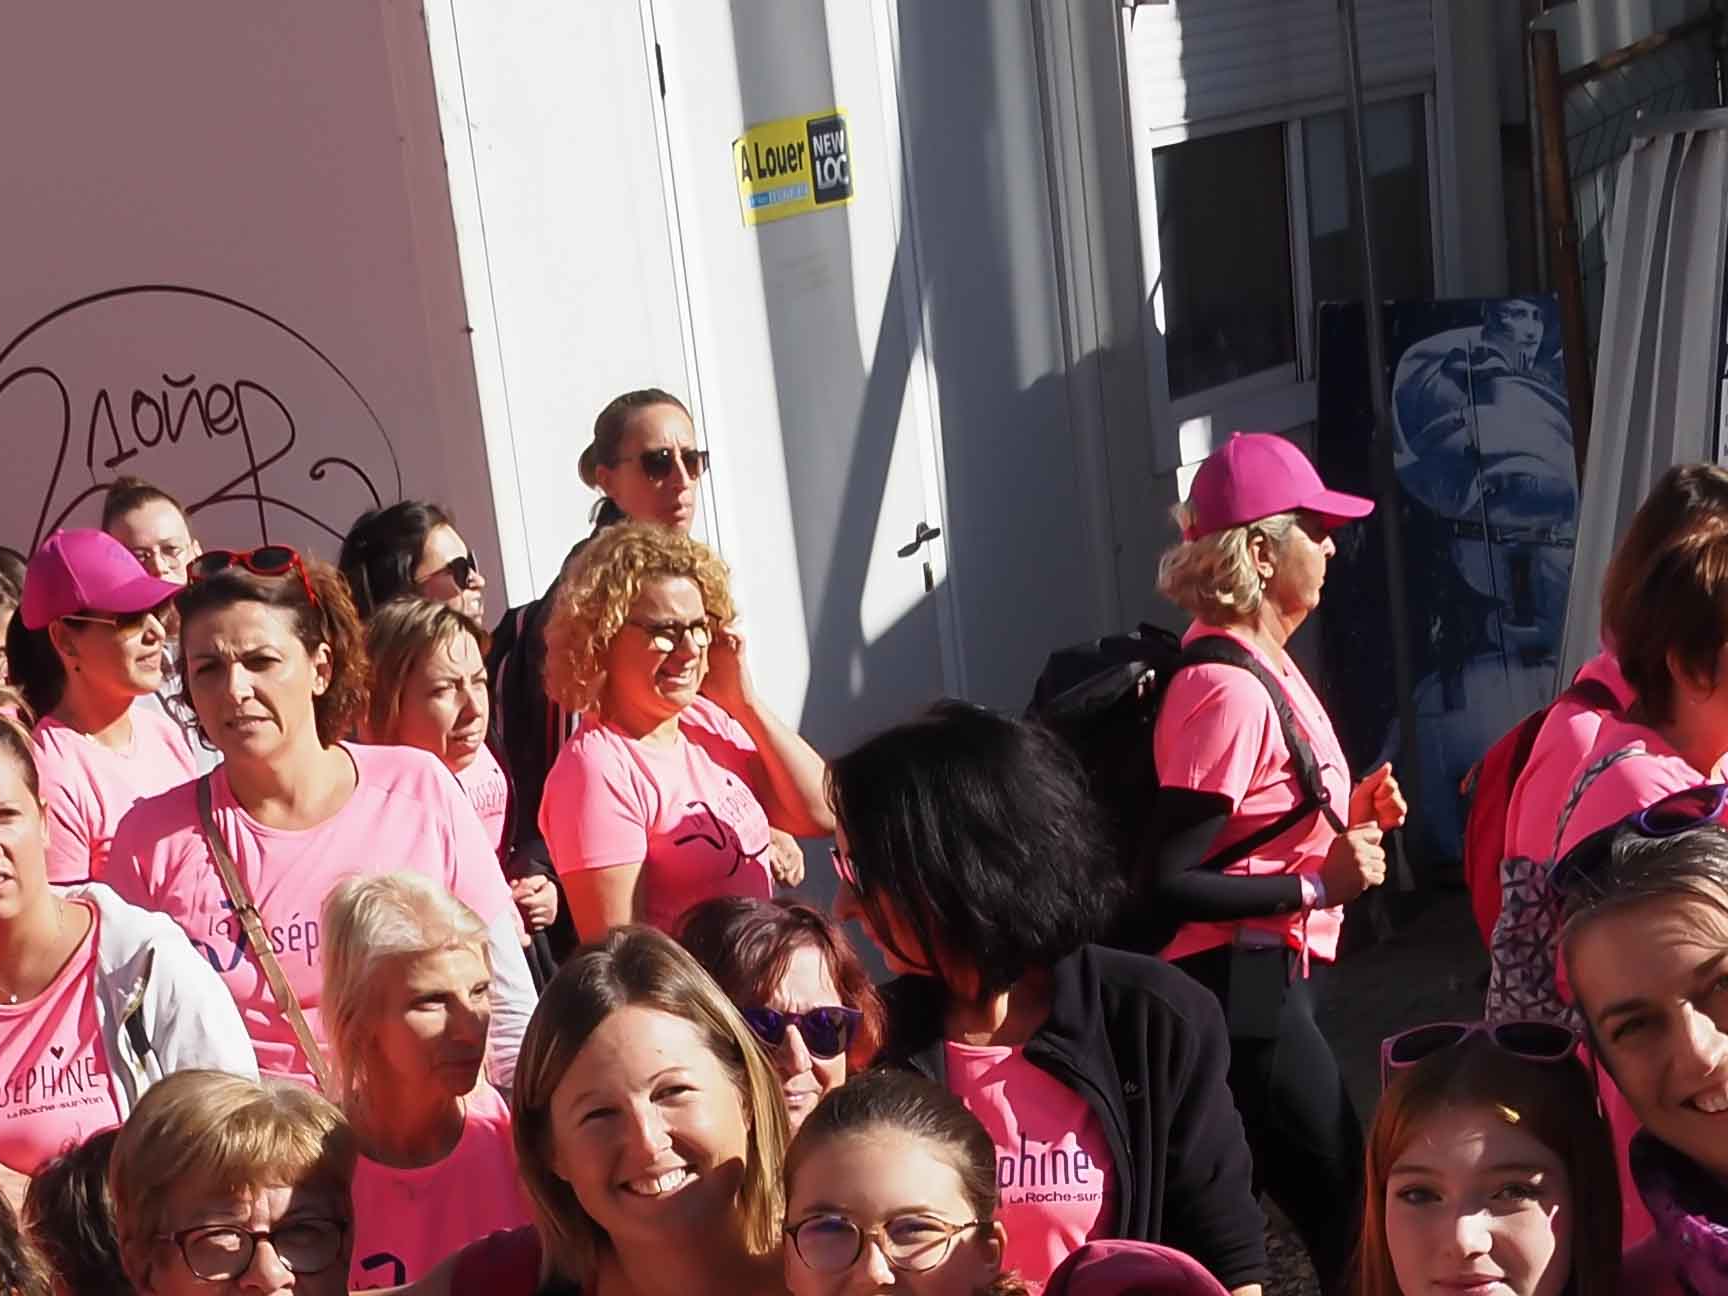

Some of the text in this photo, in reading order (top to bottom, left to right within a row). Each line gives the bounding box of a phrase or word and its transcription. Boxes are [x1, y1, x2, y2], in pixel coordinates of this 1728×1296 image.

[754, 141, 804, 179] Louer
[813, 130, 844, 158] NEW
[816, 155, 849, 189] LOC
